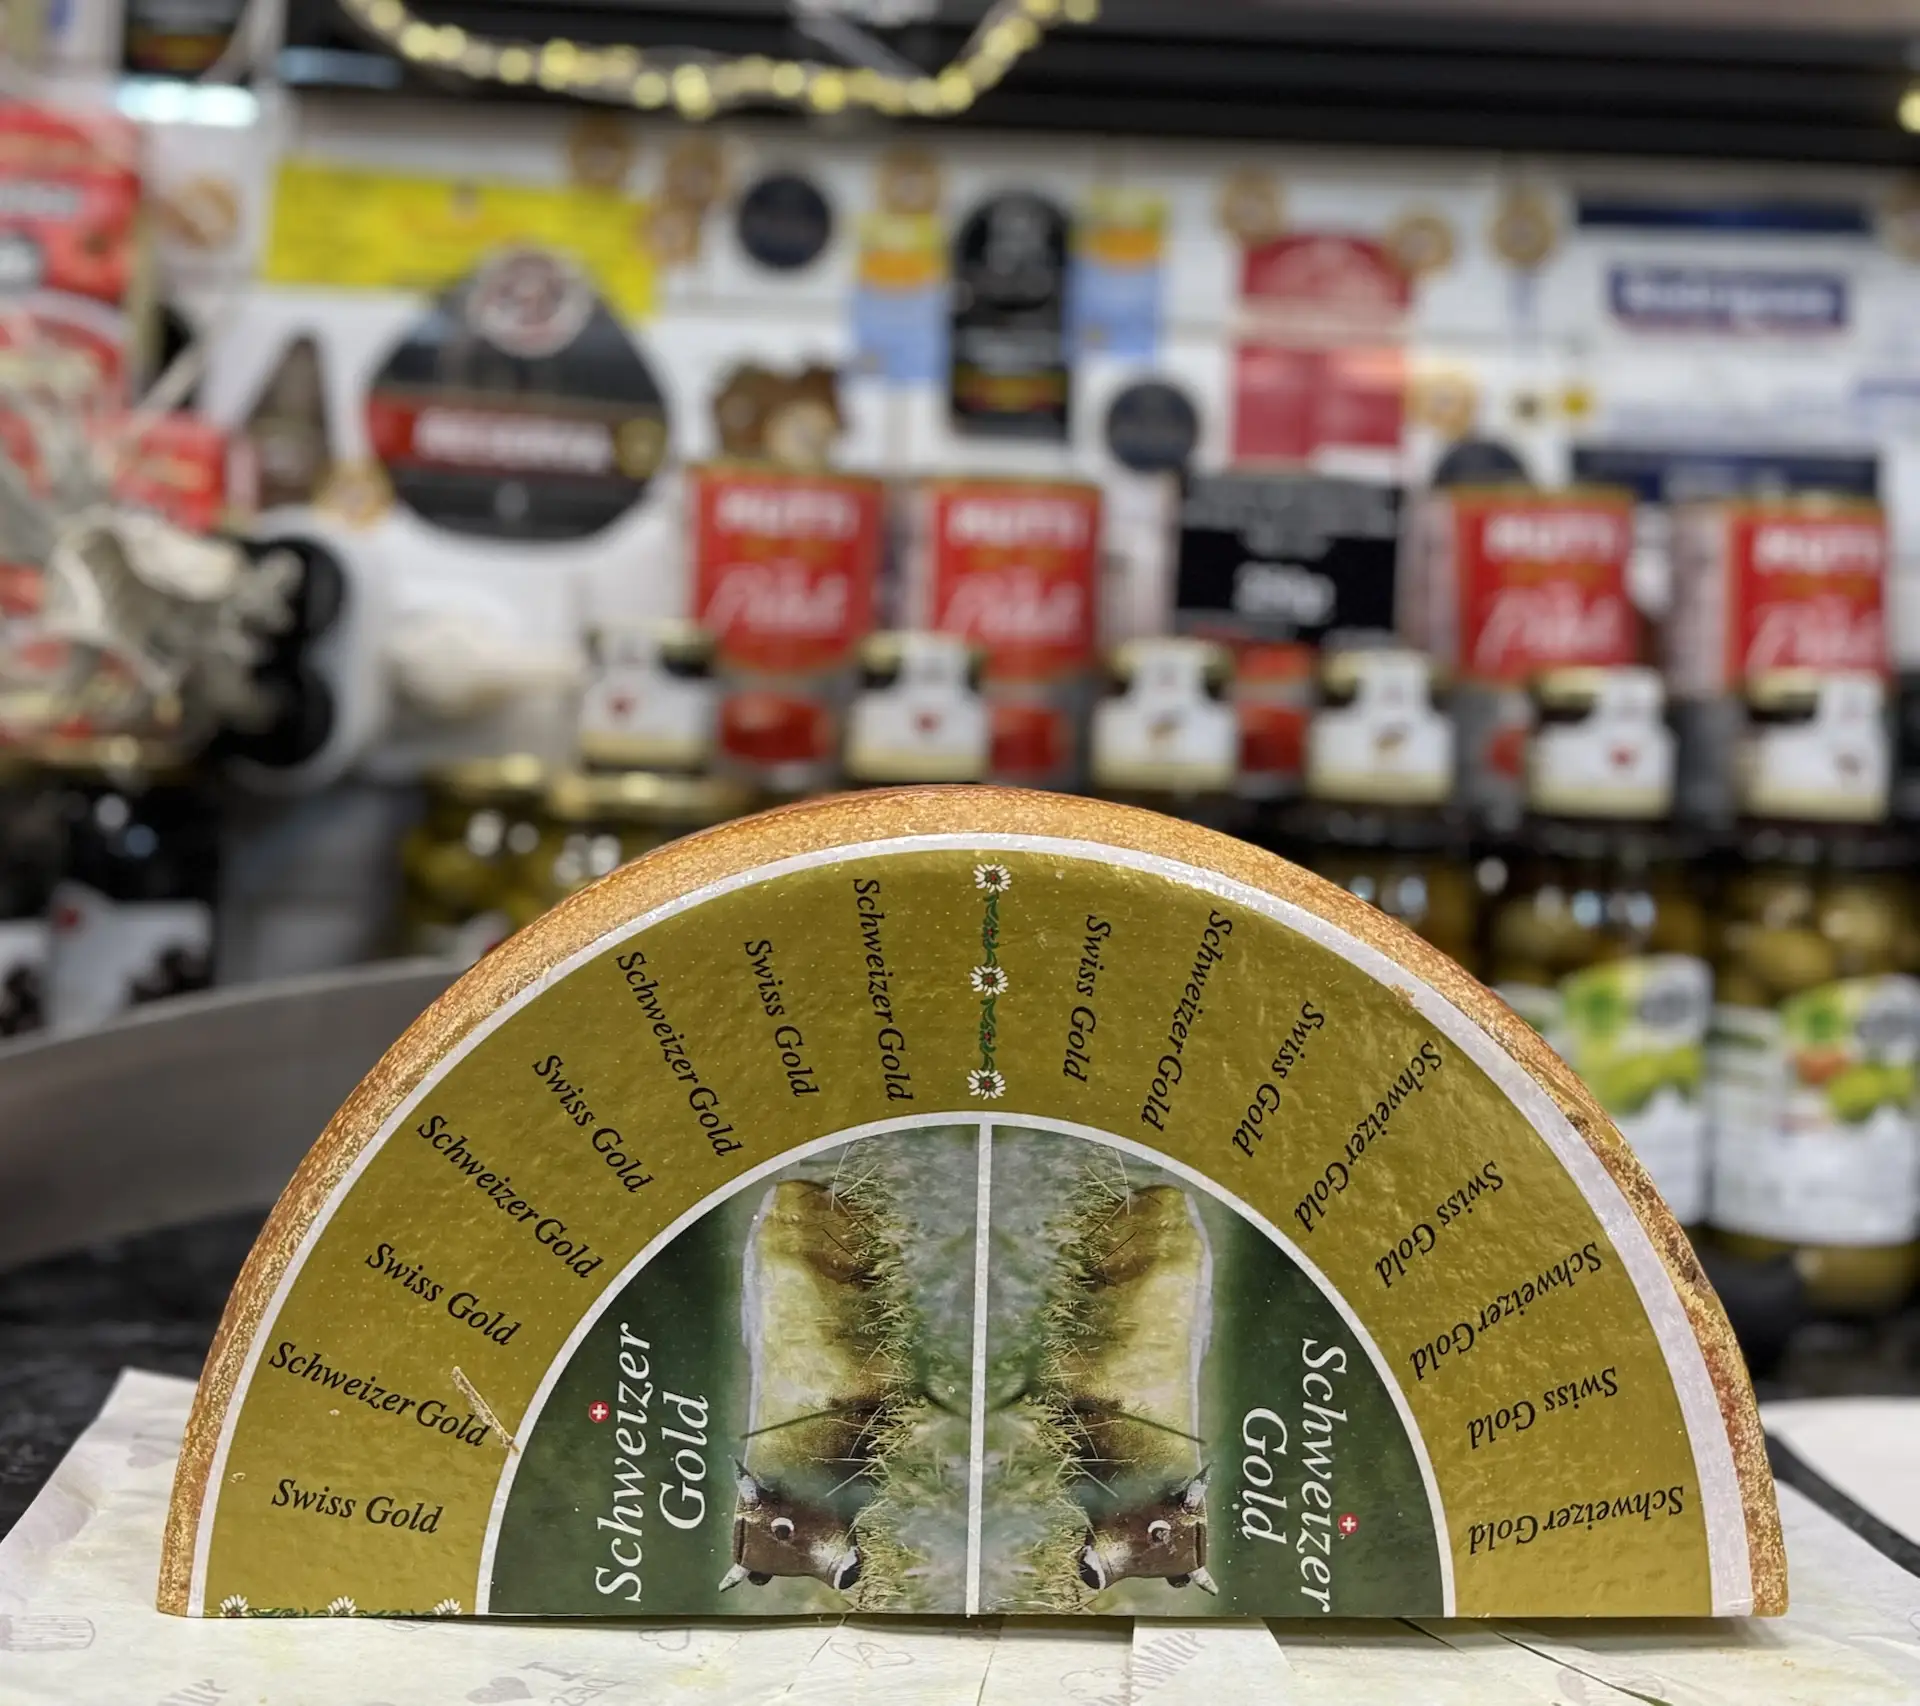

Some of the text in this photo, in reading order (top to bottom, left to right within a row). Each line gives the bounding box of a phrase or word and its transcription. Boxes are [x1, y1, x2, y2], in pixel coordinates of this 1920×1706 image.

[615, 951, 744, 1157] Schweizer Gold
[743, 938, 821, 1098] Swiss Gold
[853, 878, 915, 1102] Schweizer Gold
[1062, 914, 1112, 1083] Swiss Gold
[1140, 909, 1234, 1132] Schweizer Gold
[531, 1054, 655, 1194] Swiss Gold
[1231, 1000, 1325, 1158] Swiss Gold
[1293, 1040, 1442, 1234] Schweizer Gold
[415, 1114, 604, 1279] Schweizer Gold
[1374, 1160, 1504, 1289] Swiss Gold
[364, 1242, 522, 1346] Swiss Gold
[1409, 1241, 1602, 1381] Schweizer Gold
[268, 1341, 491, 1447] Schweizer Gold
[594, 1322, 653, 1602] Schweizer
[659, 1391, 709, 1529] Gold
[1466, 1366, 1618, 1450] Swiss Gold
[271, 1479, 443, 1534] Swiss Gold
[1241, 1408, 1289, 1545] Gold
[1297, 1338, 1347, 1614] Schweizer
[1468, 1486, 1684, 1555] Schweizer Gold
